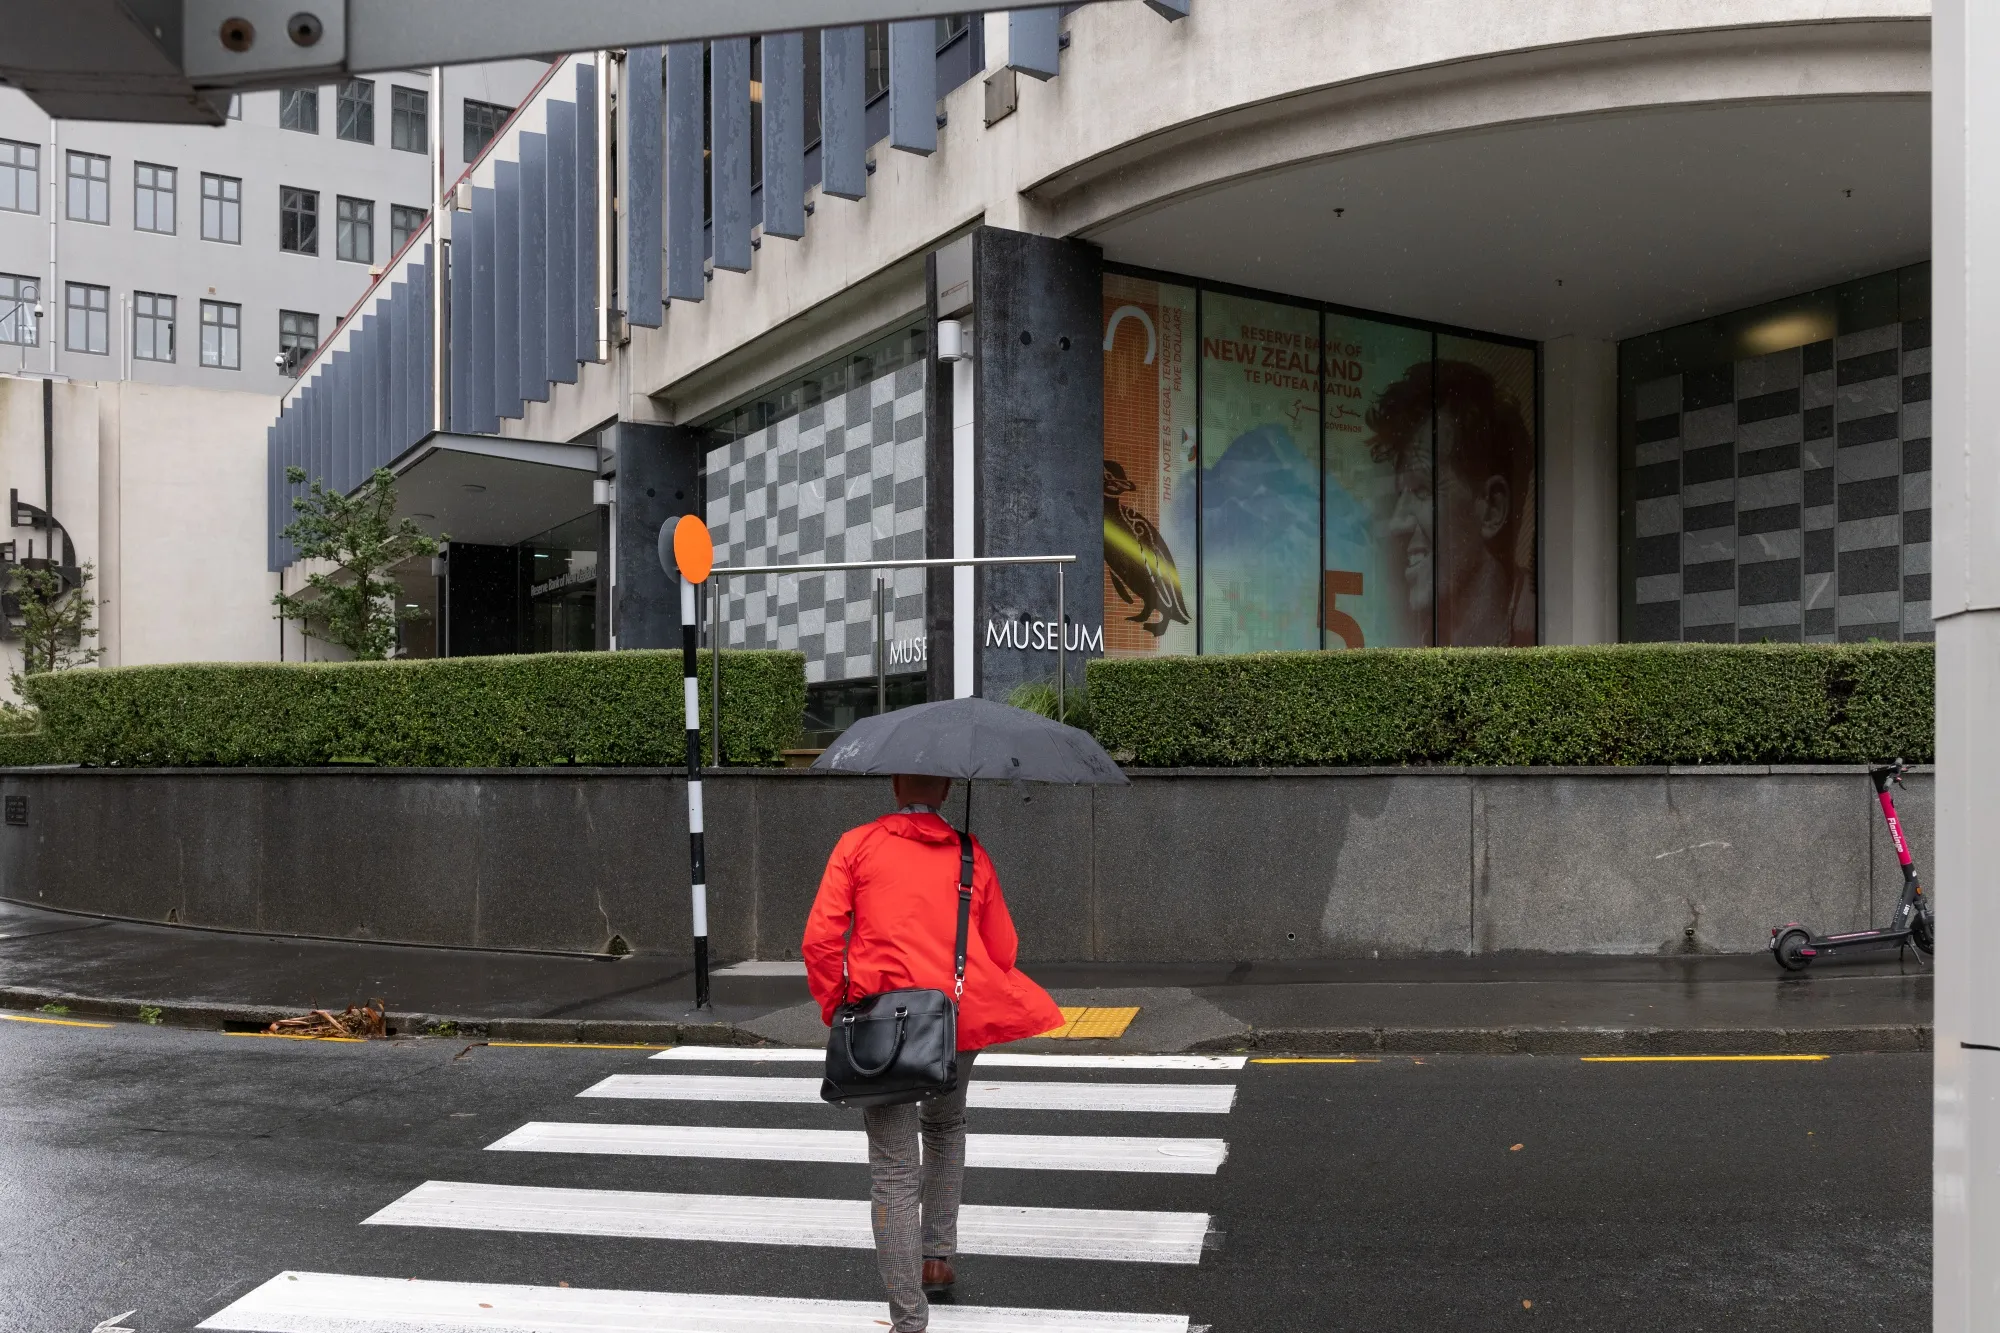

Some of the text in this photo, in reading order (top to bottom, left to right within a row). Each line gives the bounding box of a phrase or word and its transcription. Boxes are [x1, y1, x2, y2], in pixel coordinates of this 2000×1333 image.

[1174, 307, 1182, 392] FIVE DOLLARS
[1241, 325, 1362, 357] RESERVE BANK OF
[1203, 337, 1363, 382] NEW ZEALAND
[1244, 369, 1362, 399] TE PŪTEA MATUA
[1163, 305, 1171, 501] THIS NOTE IS LEGAL TENDER FOR
[1324, 421, 1362, 433] GOVERNOR
[531, 583, 547, 596] Reserve
[549, 576, 560, 590] Bank
[986, 619, 1104, 652] MUSEUM
[1887, 818, 1904, 853] Flamingo
